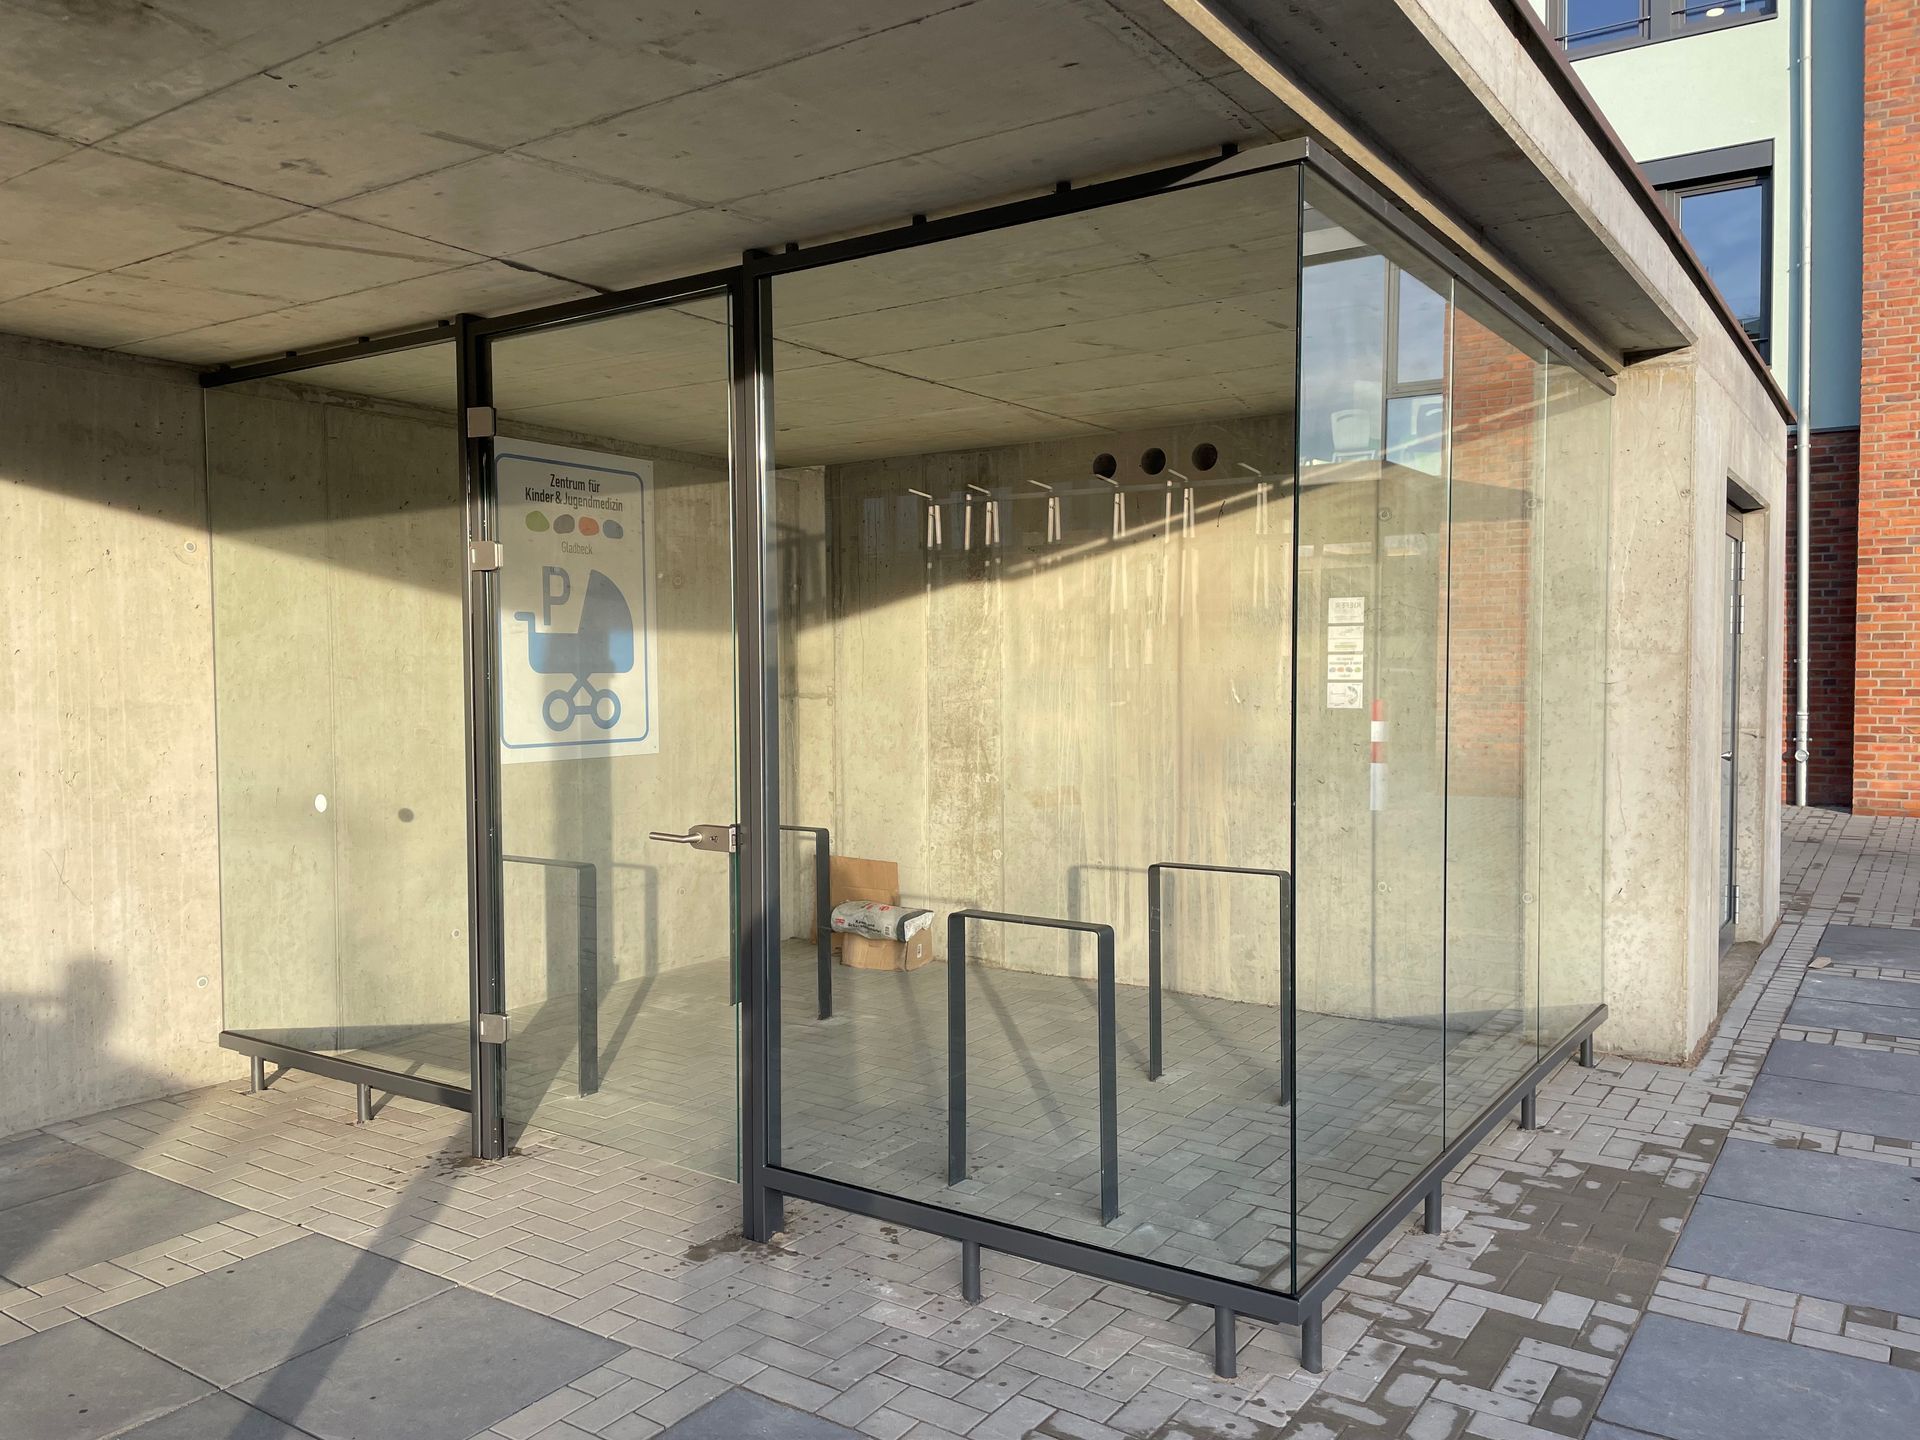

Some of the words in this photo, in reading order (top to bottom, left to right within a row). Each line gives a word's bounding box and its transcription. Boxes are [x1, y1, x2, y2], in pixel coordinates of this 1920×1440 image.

[550, 473, 586, 492] Zentrum
[588, 479, 601, 493] für
[525, 487, 554, 503] Kinder
[555, 491, 562, 504] &
[563, 491, 623, 512] Jugendmedizin
[561, 541, 593, 555] Gladbeck
[543, 565, 571, 626] P
